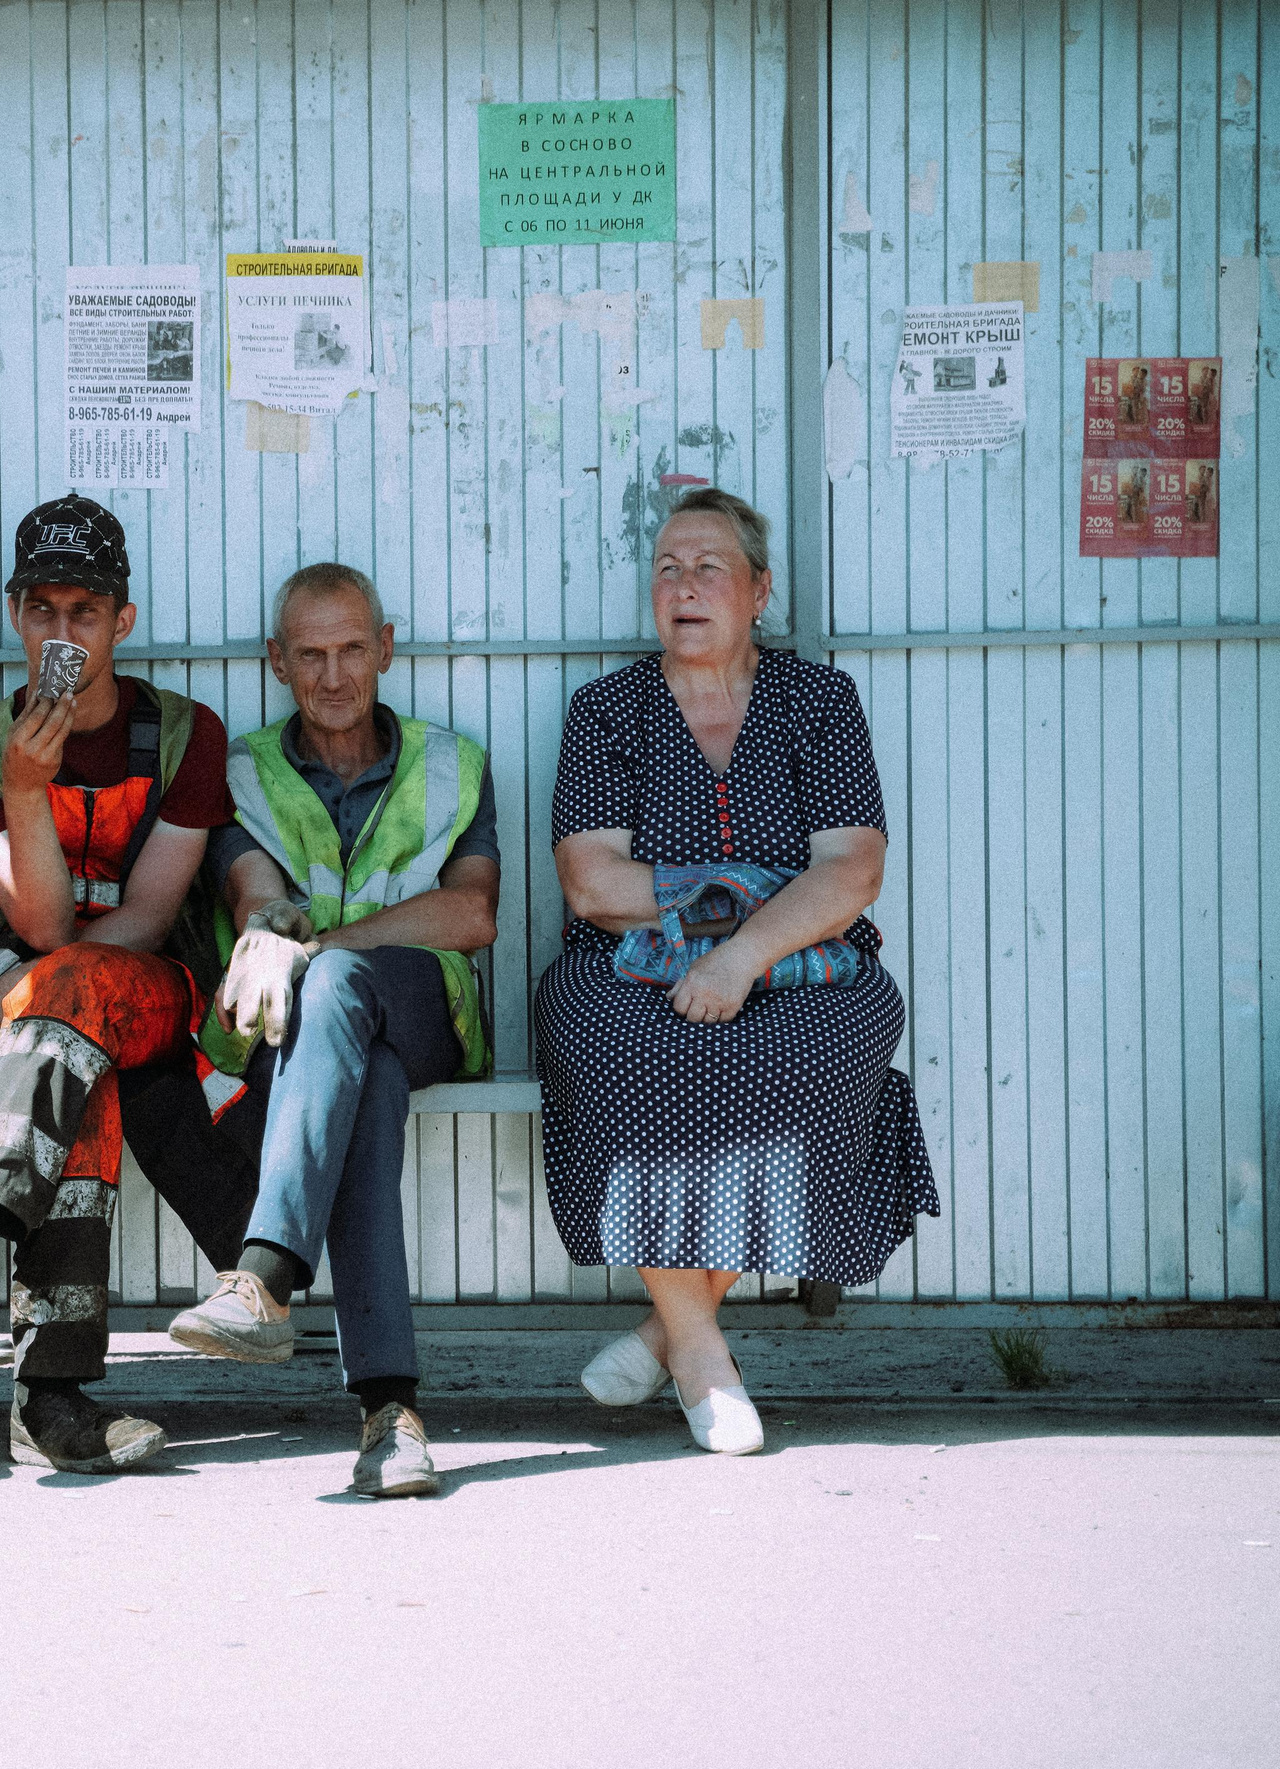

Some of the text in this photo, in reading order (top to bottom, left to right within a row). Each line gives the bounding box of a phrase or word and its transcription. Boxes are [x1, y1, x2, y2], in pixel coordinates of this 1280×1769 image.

[518, 110, 635, 126] ЯРМАРКА
[521, 137, 632, 153] В СОСНОВО
[488, 161, 665, 182] НА ЦЕНТРАЛЬНОЙ
[500, 190, 653, 207] ПЛОЩАДИ У ДК
[504, 217, 644, 233] С 06 ПО 11 ИЮНЯ
[236, 263, 359, 277] СТРОИТЕЛЬНАЯ БРИГАДА
[68, 295, 197, 309] УВАЖАЕМЫЕ САДОВОДЫ!
[238, 295, 353, 307] УСЛУГИ ПЕЧНИКА
[69, 309, 195, 318] ВСЕ ВИДЫ СТРОИТЕЛЬНЫХ РАБОТ:
[973, 317, 1021, 328] БРИГАДА
[903, 328, 1021, 346] ЕМОНТ КРЫШ
[952, 347, 980, 355] ДОРОГО
[983, 345, 1012, 353] СТРОИМ
[119, 386, 191, 395] МАТЕРИАЛОМ!
[1091, 375, 1113, 395] 15
[1160, 375, 1183, 395] 15
[68, 406, 191, 423] 8-965-785-61-19 Андрей
[1088, 418, 1115, 430] 20%
[1157, 418, 1185, 430] 20%
[983, 435, 1008, 445] СКИДКА
[1089, 474, 1113, 494] 15
[1157, 474, 1181, 494] 15
[1085, 516, 1114, 528] 20%
[1154, 516, 1182, 528] 20%
[36, 523, 92, 547] UFC
